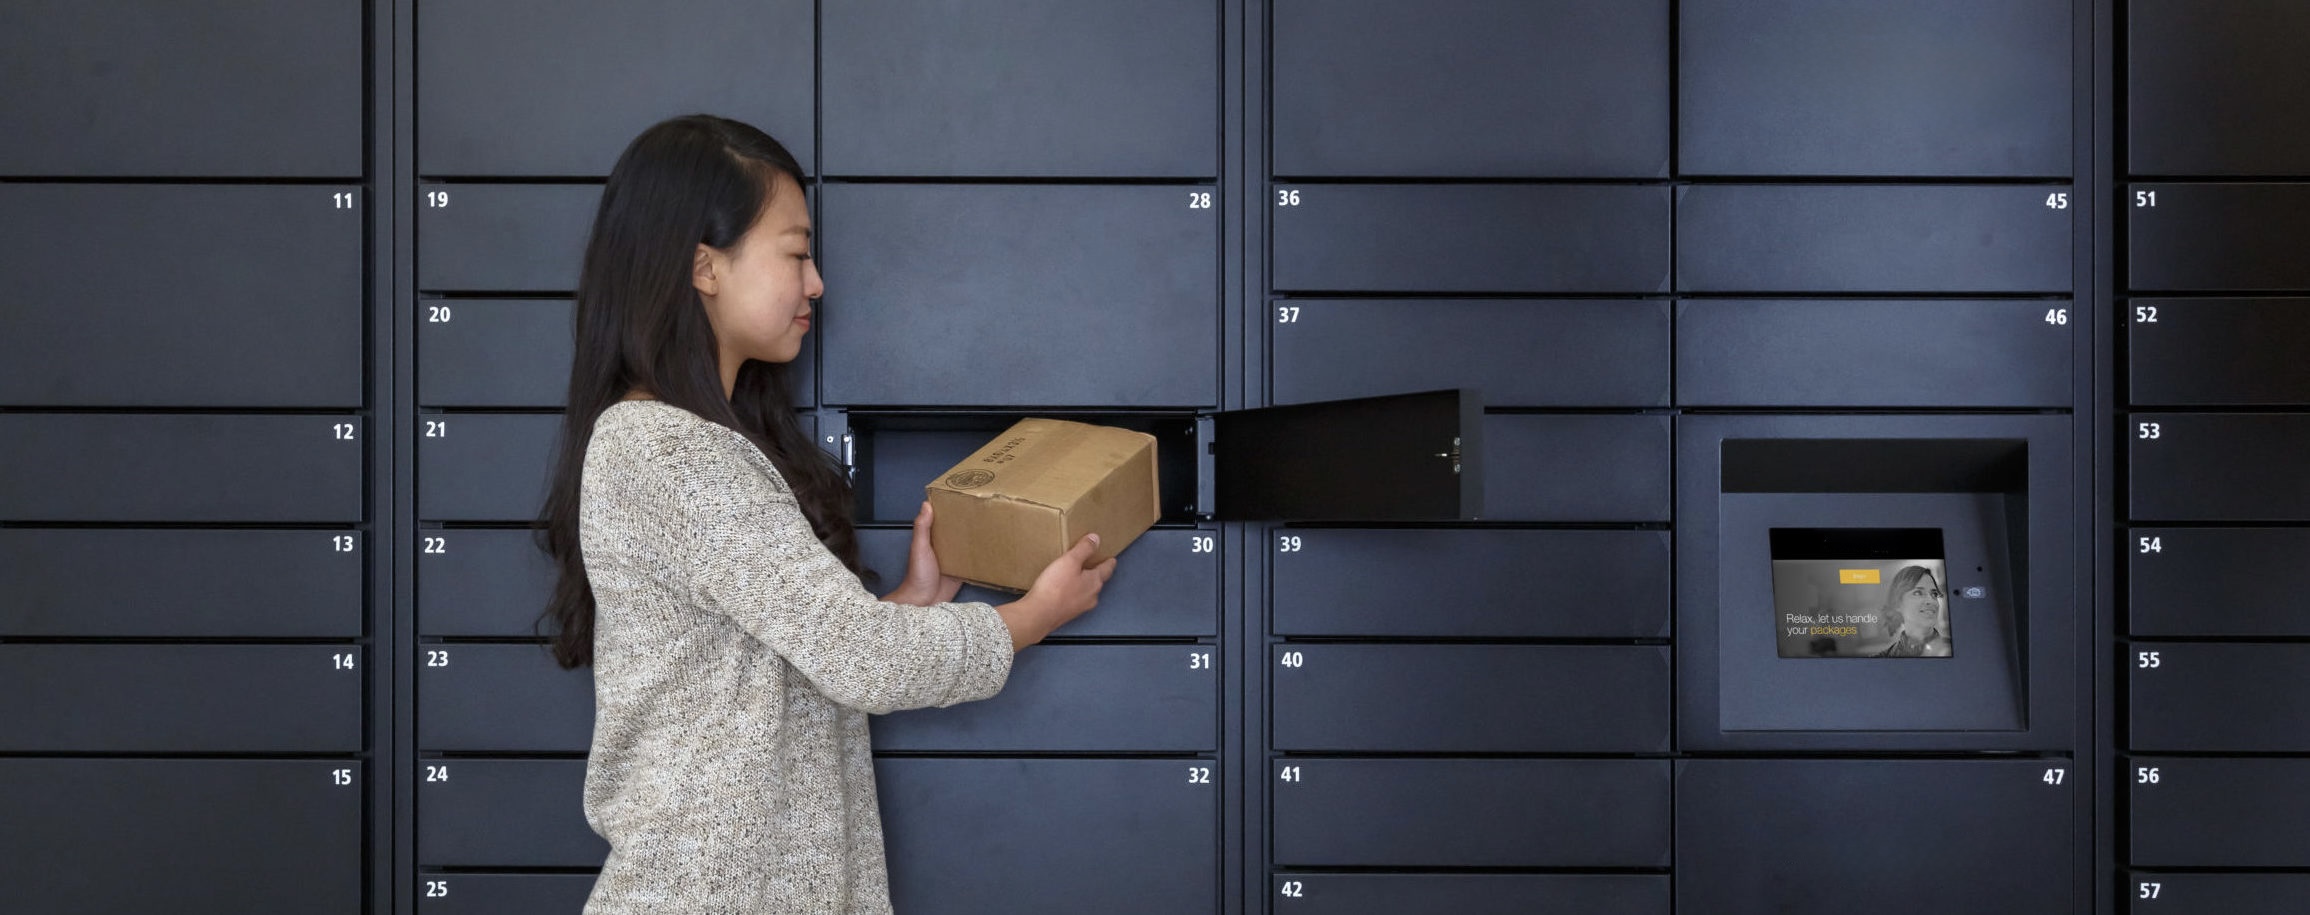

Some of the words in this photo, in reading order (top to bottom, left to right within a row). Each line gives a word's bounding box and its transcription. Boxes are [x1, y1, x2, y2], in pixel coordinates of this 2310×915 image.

[333, 192, 352, 209] 11
[427, 191, 449, 208] 19
[1189, 192, 1212, 209] 28
[1278, 189, 1301, 207] 36
[2045, 192, 2068, 210] 45
[2136, 190, 2156, 207] 51
[428, 306, 451, 323] 20
[1278, 306, 1300, 324] 37
[2044, 308, 2068, 326] 46
[2136, 306, 2158, 323] 52
[333, 423, 354, 440] 12
[425, 420, 446, 438] 21
[2139, 422, 2160, 439] 53
[332, 535, 354, 553] 13
[424, 537, 446, 554] 22
[1191, 536, 1214, 553] 30
[1280, 535, 1302, 553] 39
[2140, 536, 2162, 554] 54
[1786, 613, 1816, 624] Relax,
[1818, 613, 1830, 624] let
[1832, 615, 1844, 624] us
[1845, 613, 1878, 624] handle
[1786, 626, 1807, 637] your
[1810, 625, 1857, 636] packages
[332, 653, 355, 670] 14
[427, 650, 449, 667] 23
[1189, 652, 1210, 670] 31
[1281, 651, 1304, 668] 40
[2139, 651, 2160, 668] 55
[332, 768, 352, 786] 15
[426, 765, 449, 782] 24
[1188, 766, 1210, 784] 32
[1280, 765, 1300, 783] 41
[2042, 768, 2065, 785] 47
[2138, 767, 2160, 784] 56
[426, 880, 448, 898] 25
[1281, 881, 1303, 898] 42
[2139, 882, 2161, 899] 57
